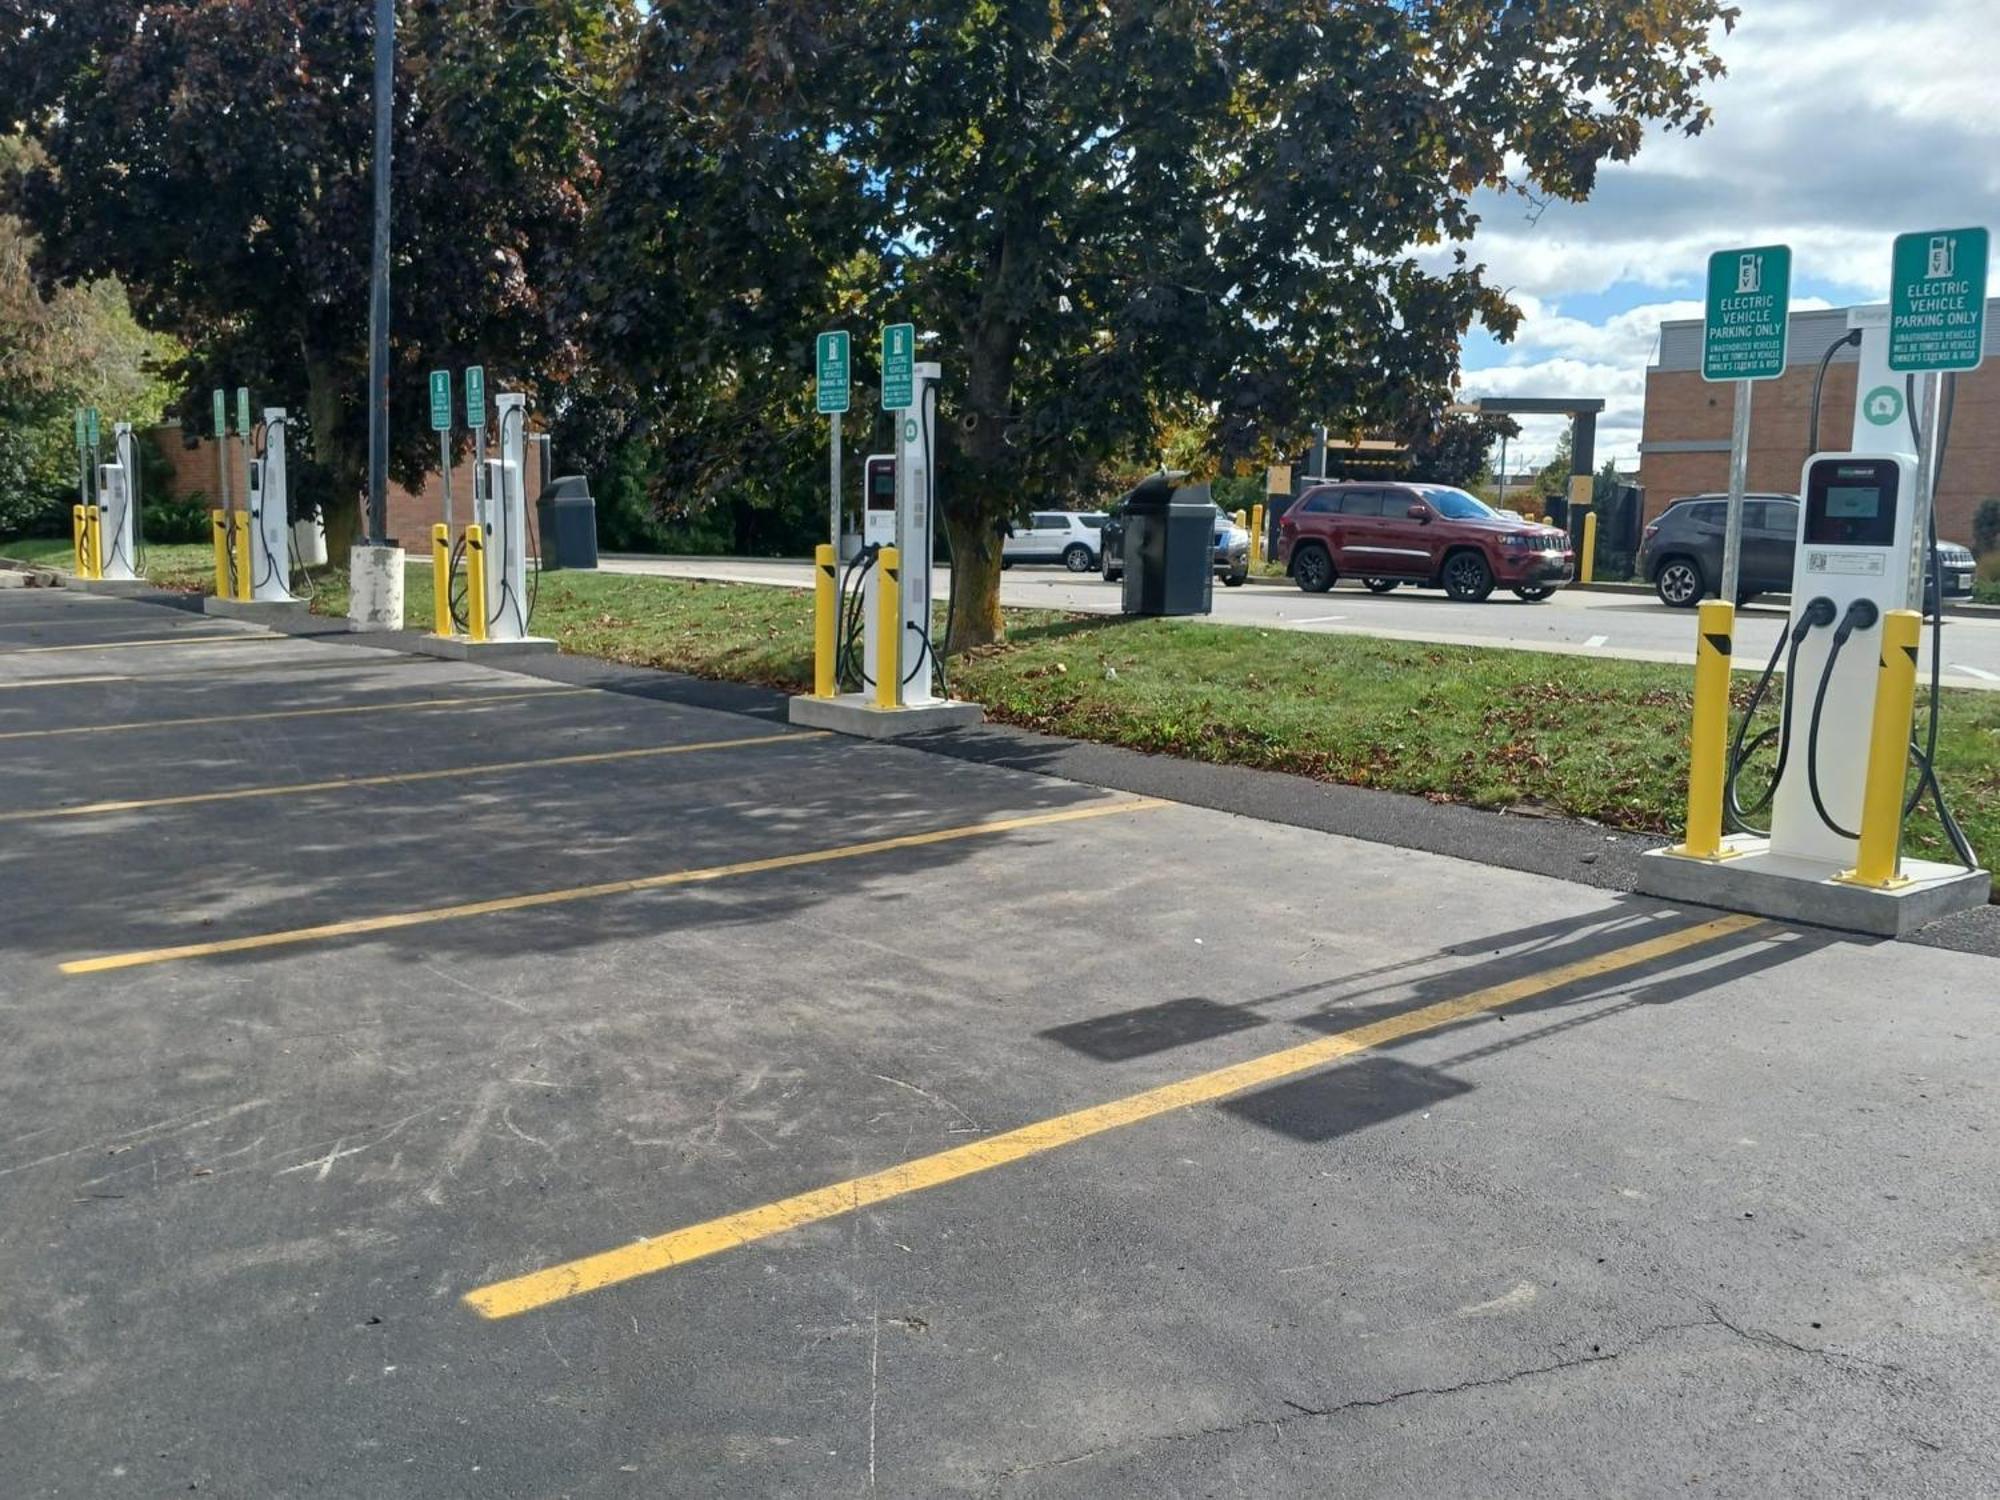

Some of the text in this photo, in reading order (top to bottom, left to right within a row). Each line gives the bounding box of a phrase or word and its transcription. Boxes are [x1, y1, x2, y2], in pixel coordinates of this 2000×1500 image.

[1908, 281, 1969, 297] ELECTRIC
[1721, 295, 1774, 311] ELECTRIC
[1910, 297, 1965, 313] VEHICLE
[1723, 309, 1771, 324] VEHICLE
[1895, 313, 1943, 328] PARKING
[1948, 311, 1978, 325] ONLY
[1709, 323, 1781, 339] PARKING ONLY
